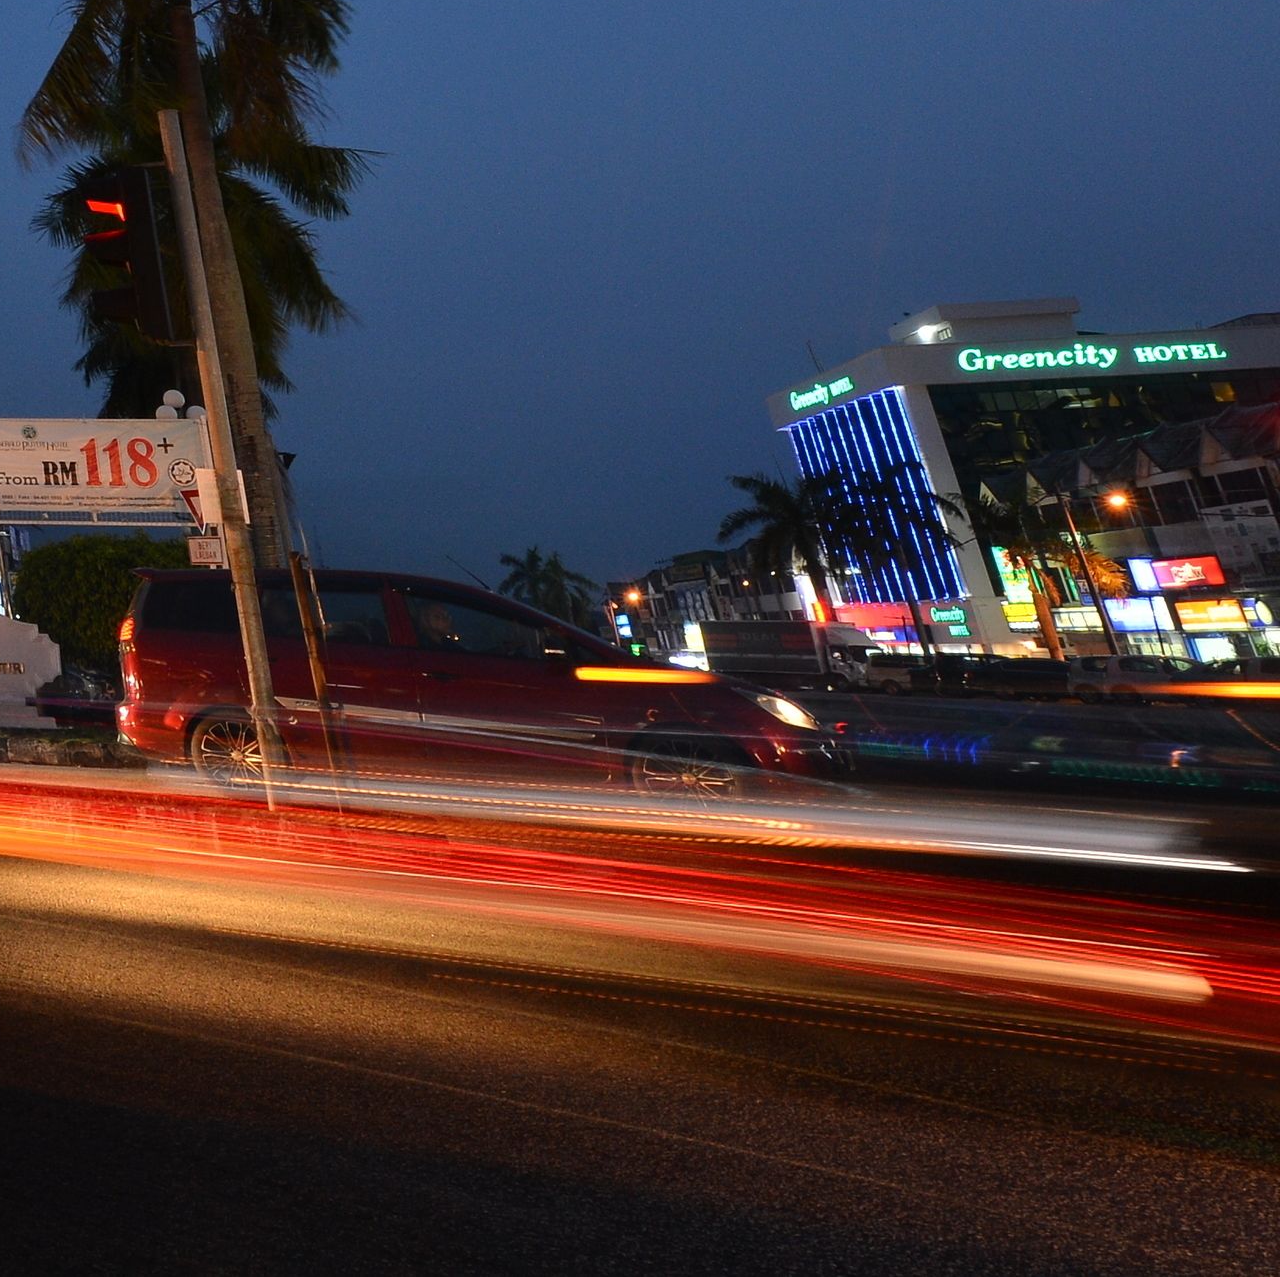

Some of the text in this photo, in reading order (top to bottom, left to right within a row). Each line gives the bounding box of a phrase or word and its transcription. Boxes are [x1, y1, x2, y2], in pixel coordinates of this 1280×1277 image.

[958, 342, 1228, 372] Greencity HOTEL
[41, 460, 79, 486] RM
